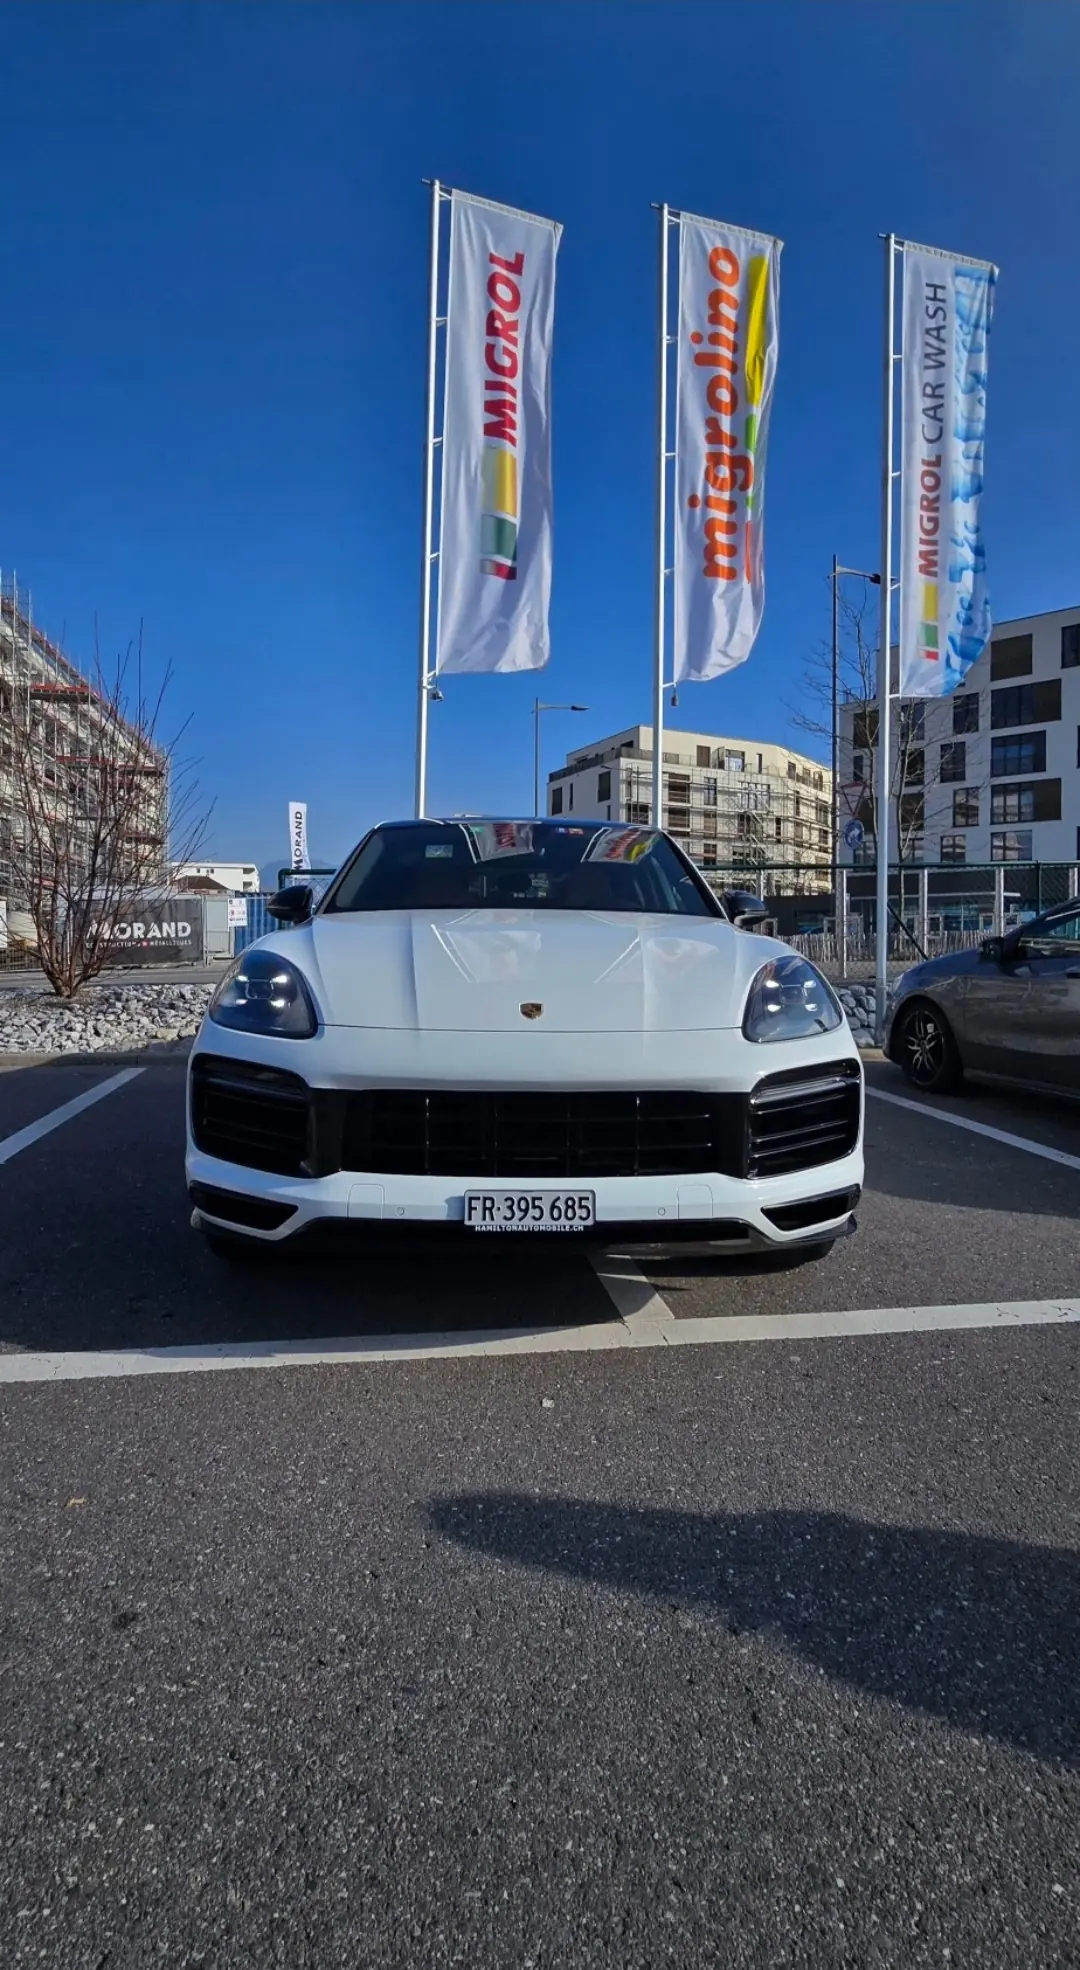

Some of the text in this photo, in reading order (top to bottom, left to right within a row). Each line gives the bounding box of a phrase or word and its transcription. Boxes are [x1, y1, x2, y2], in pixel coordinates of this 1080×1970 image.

[482, 252, 525, 448] MIGROL
[687, 245, 755, 581] migrolino
[918, 282, 948, 578] MIGROL CAR WASH
